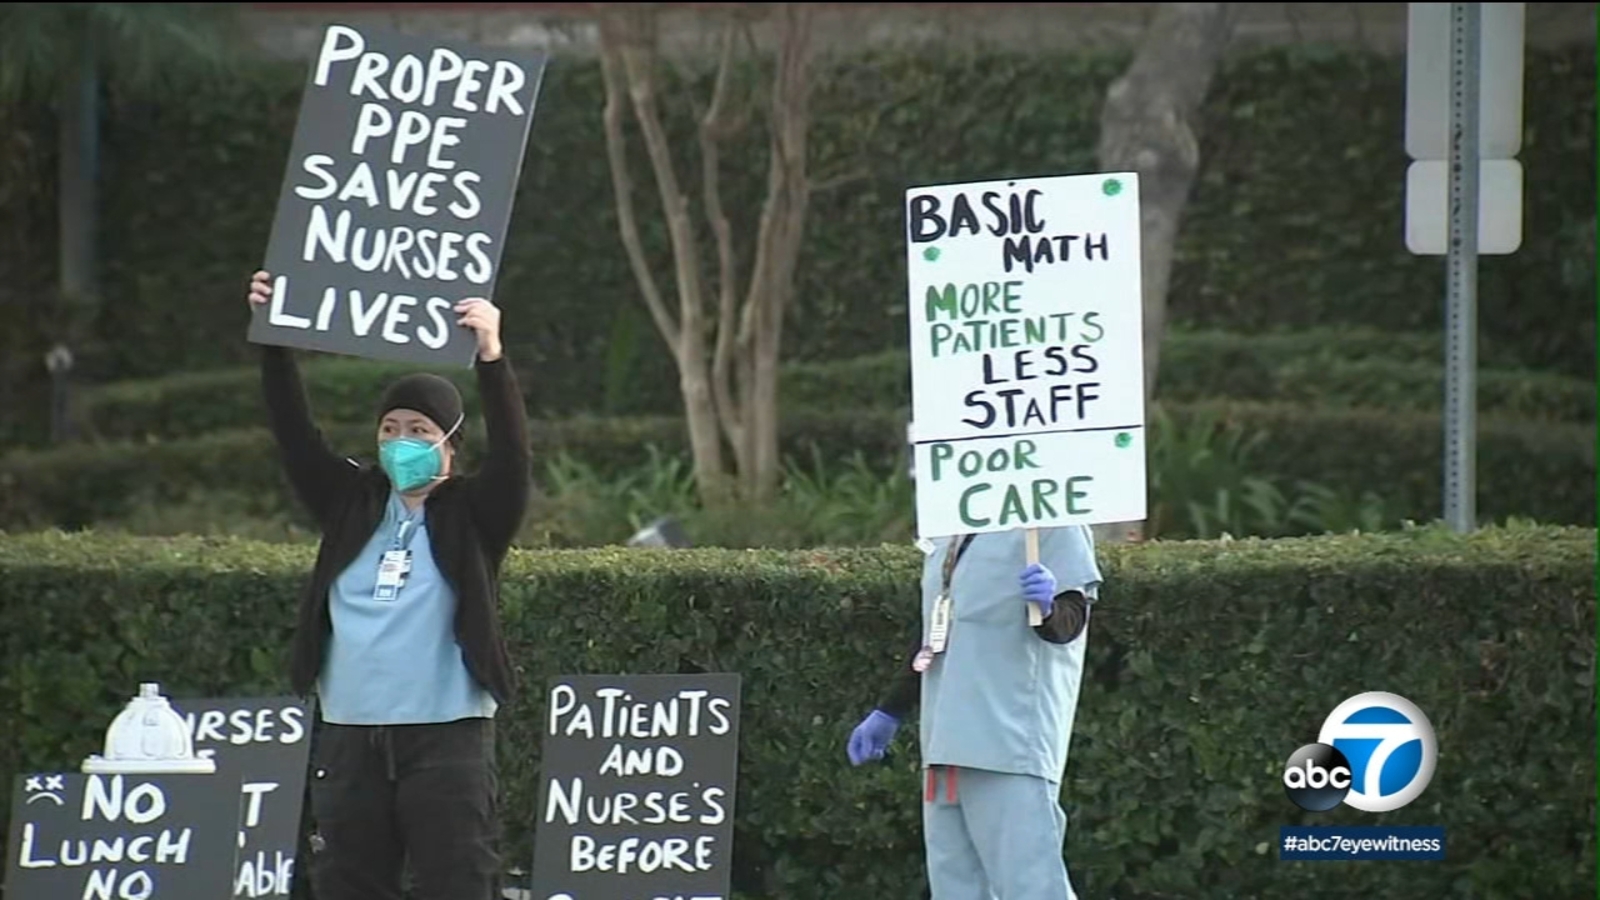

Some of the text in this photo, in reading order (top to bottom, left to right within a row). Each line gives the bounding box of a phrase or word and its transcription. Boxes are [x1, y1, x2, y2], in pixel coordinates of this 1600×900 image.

[314, 25, 526, 116] PROPER
[352, 103, 468, 170] PPE
[294, 154, 482, 220] SAVES
[303, 204, 493, 284] NURSES
[1002, 232, 1109, 274] MATH
[269, 275, 451, 350] LIVES
[925, 281, 1024, 322] MORE
[930, 311, 1105, 358] PATIENTS
[982, 344, 1098, 385] LESS
[961, 382, 1101, 430] STAFF
[930, 440, 1042, 482] POOR
[958, 475, 1094, 528] CARE
[186, 706, 304, 745] RSES
[599, 743, 684, 777] AND
[81, 774, 166, 824] NO
[19, 823, 192, 868] LUNCH
[570, 835, 716, 875] BEFORE
[82, 868, 154, 900] NO
